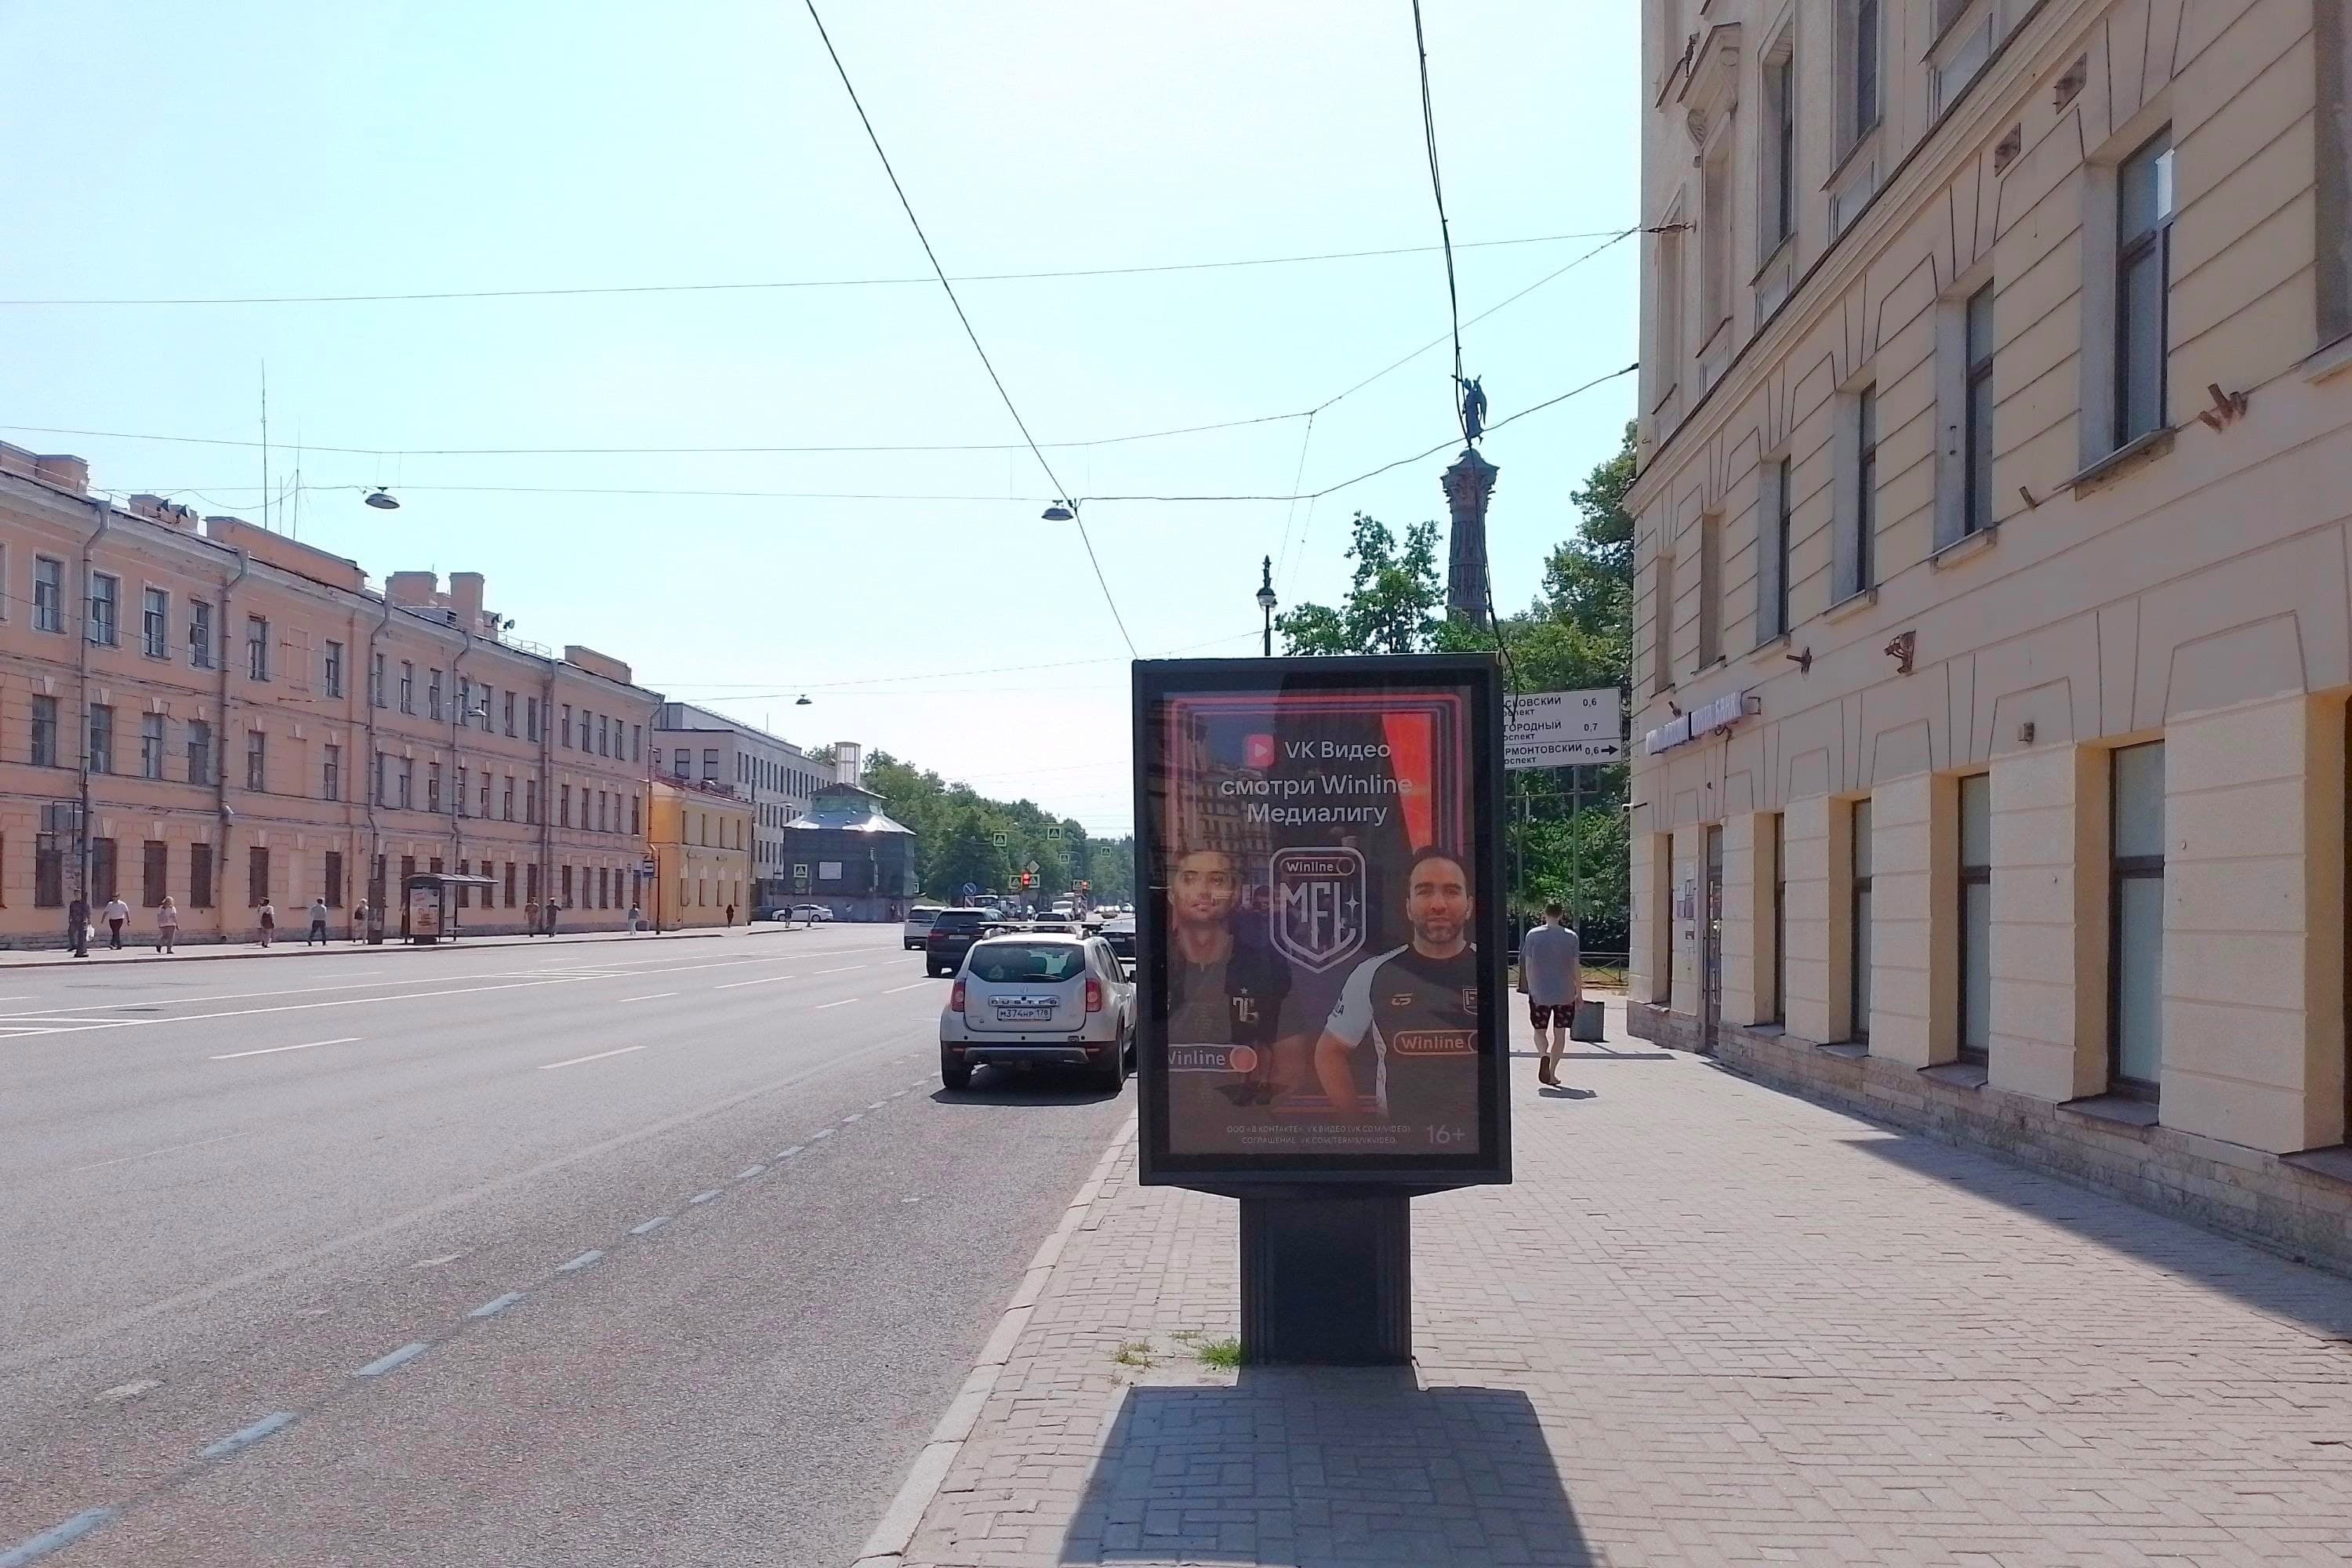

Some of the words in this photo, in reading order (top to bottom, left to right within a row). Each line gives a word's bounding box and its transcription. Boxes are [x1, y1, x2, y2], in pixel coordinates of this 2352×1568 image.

[1505, 695, 1561, 707] СОВСКИЙ
[1582, 699, 1597, 707] 0,6
[1504, 719, 1561, 732] ГОРОДНЫЙ
[1584, 723, 1598, 732] 0,7
[1284, 741, 1316, 758] VK
[1321, 741, 1391, 761] Видео
[1505, 742, 1582, 756] РМОНТОВСКИЙ
[1584, 746, 1599, 756] 0,6
[1221, 779, 1315, 800] смотри
[1320, 774, 1412, 794] Winline
[1247, 803, 1388, 826] Медиалигу
[1287, 861, 1334, 872] Winline
[1401, 1036, 1465, 1050] Winline
[1427, 1124, 1465, 1144] 16+
